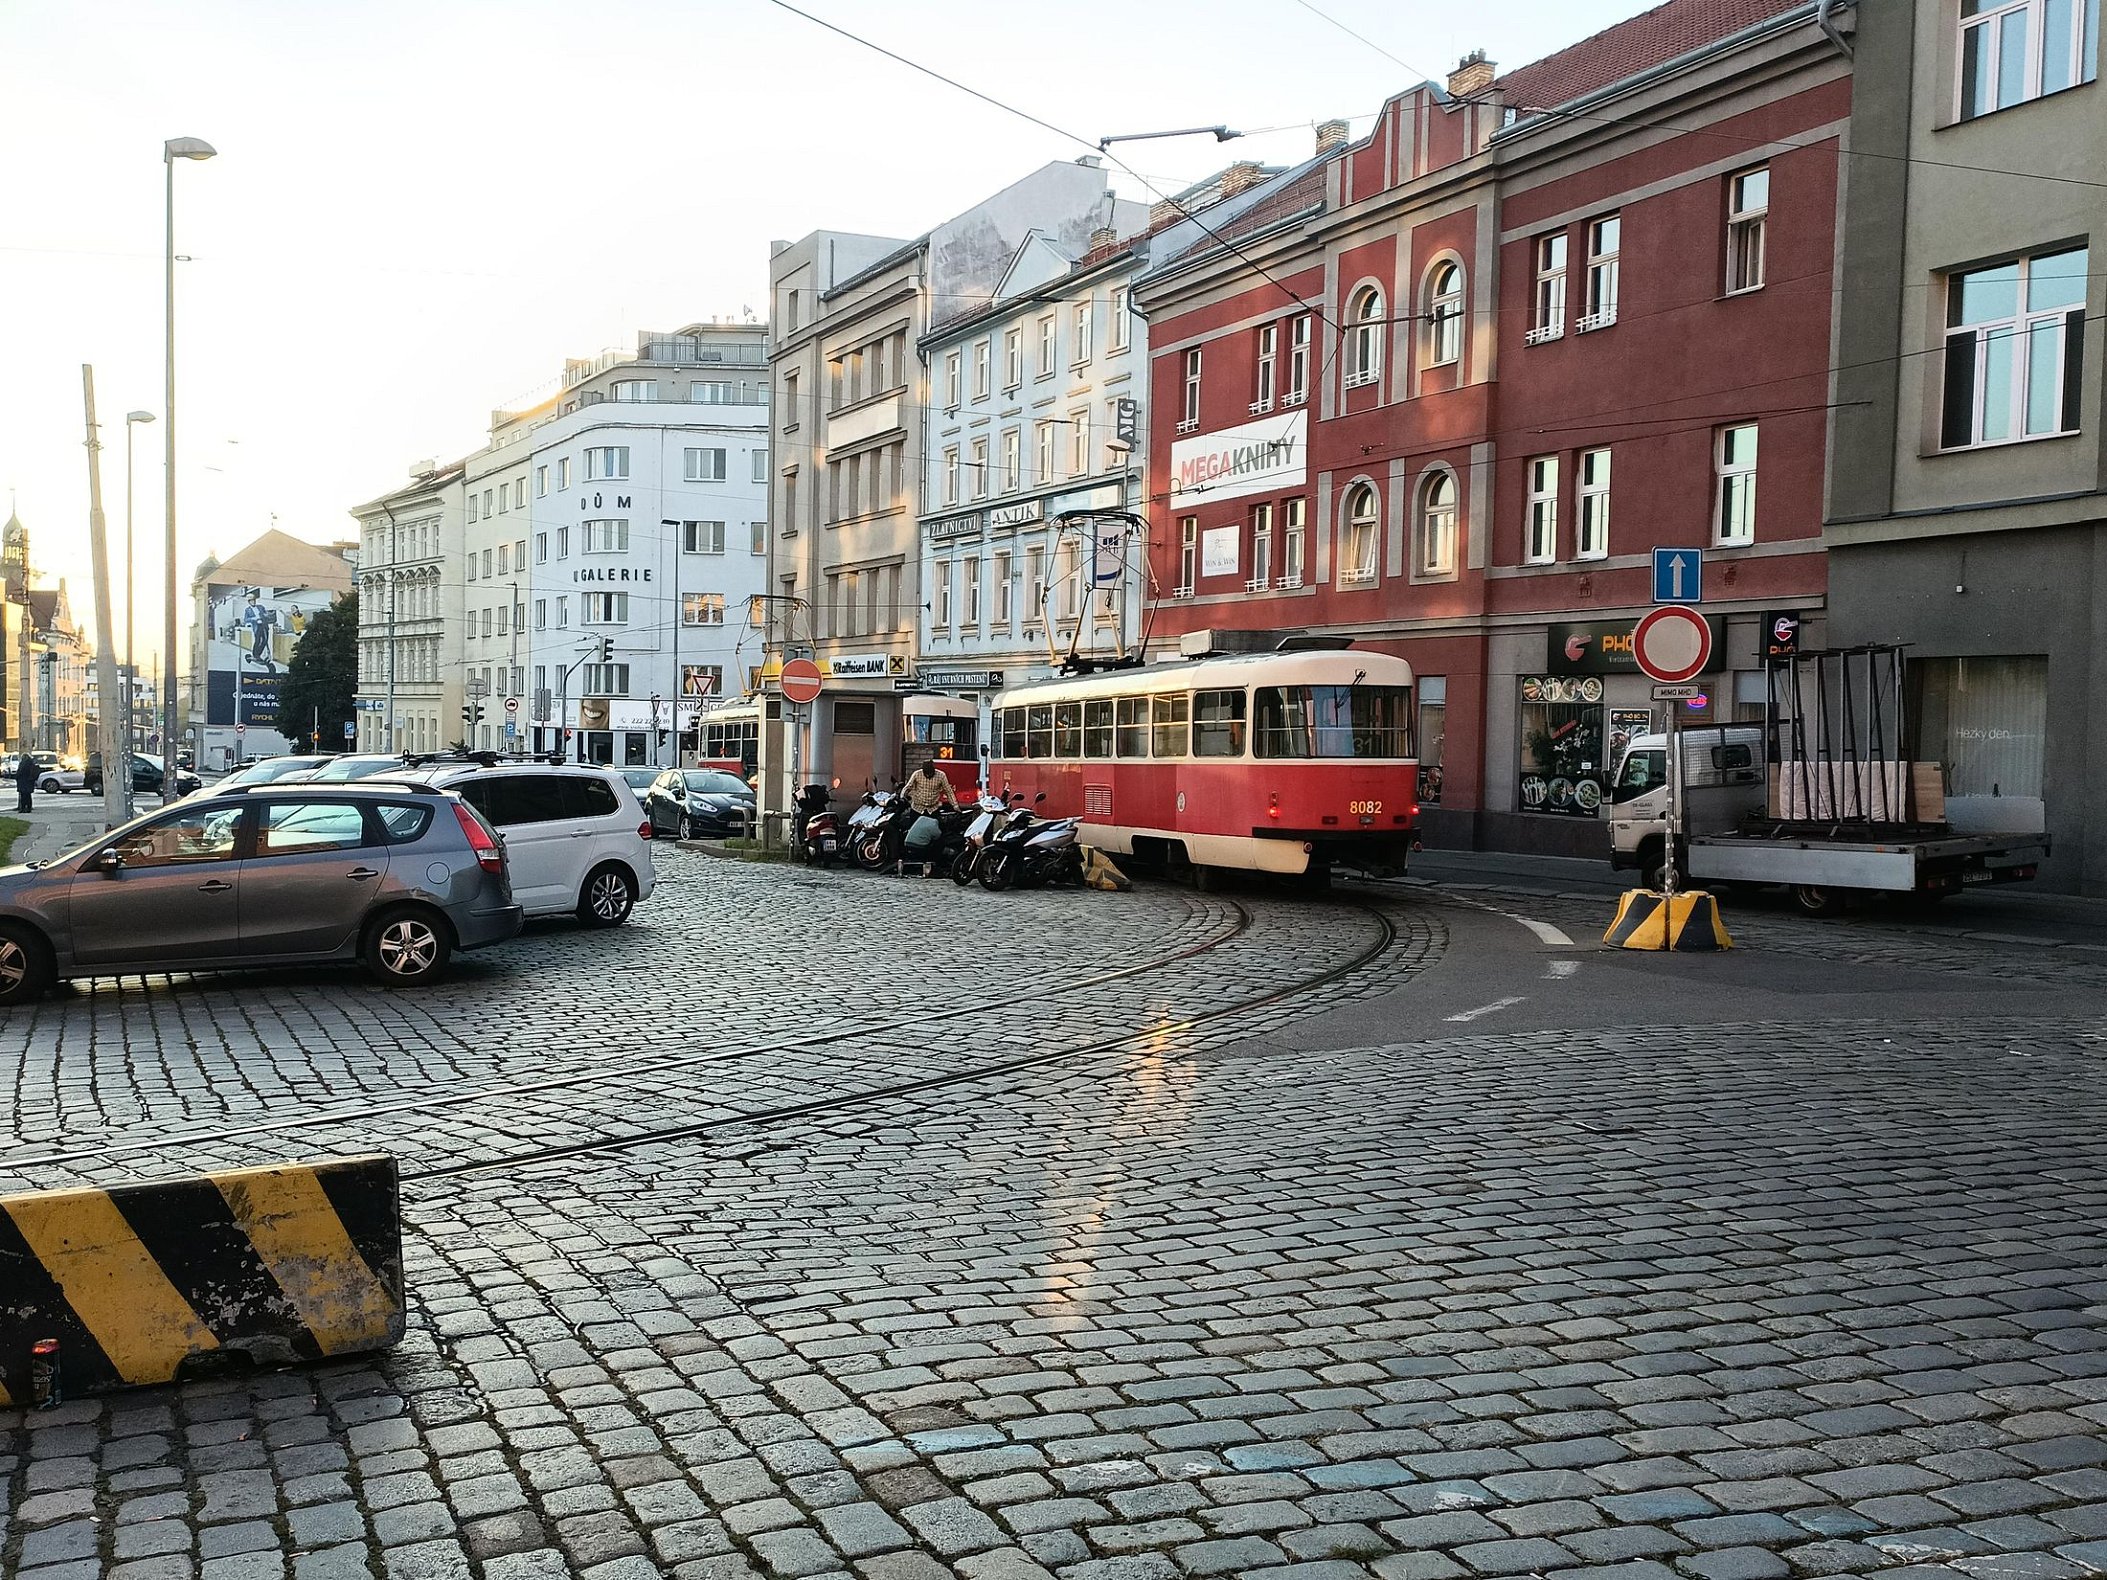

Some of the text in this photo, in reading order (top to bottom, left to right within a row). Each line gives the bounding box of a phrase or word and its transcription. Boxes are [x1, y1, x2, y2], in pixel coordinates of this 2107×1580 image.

[1181, 435, 1297, 486] MEGAKNIHY
[581, 492, 631, 510] DŮM
[992, 503, 1036, 523] ANTIK
[931, 514, 977, 536] ZLATNICTVÍ
[581, 568, 652, 582] GALERIE
[837, 659, 885, 674] Raiffeisen BANK
[939, 746, 954, 759] 31
[1349, 800, 1382, 814] 8082
